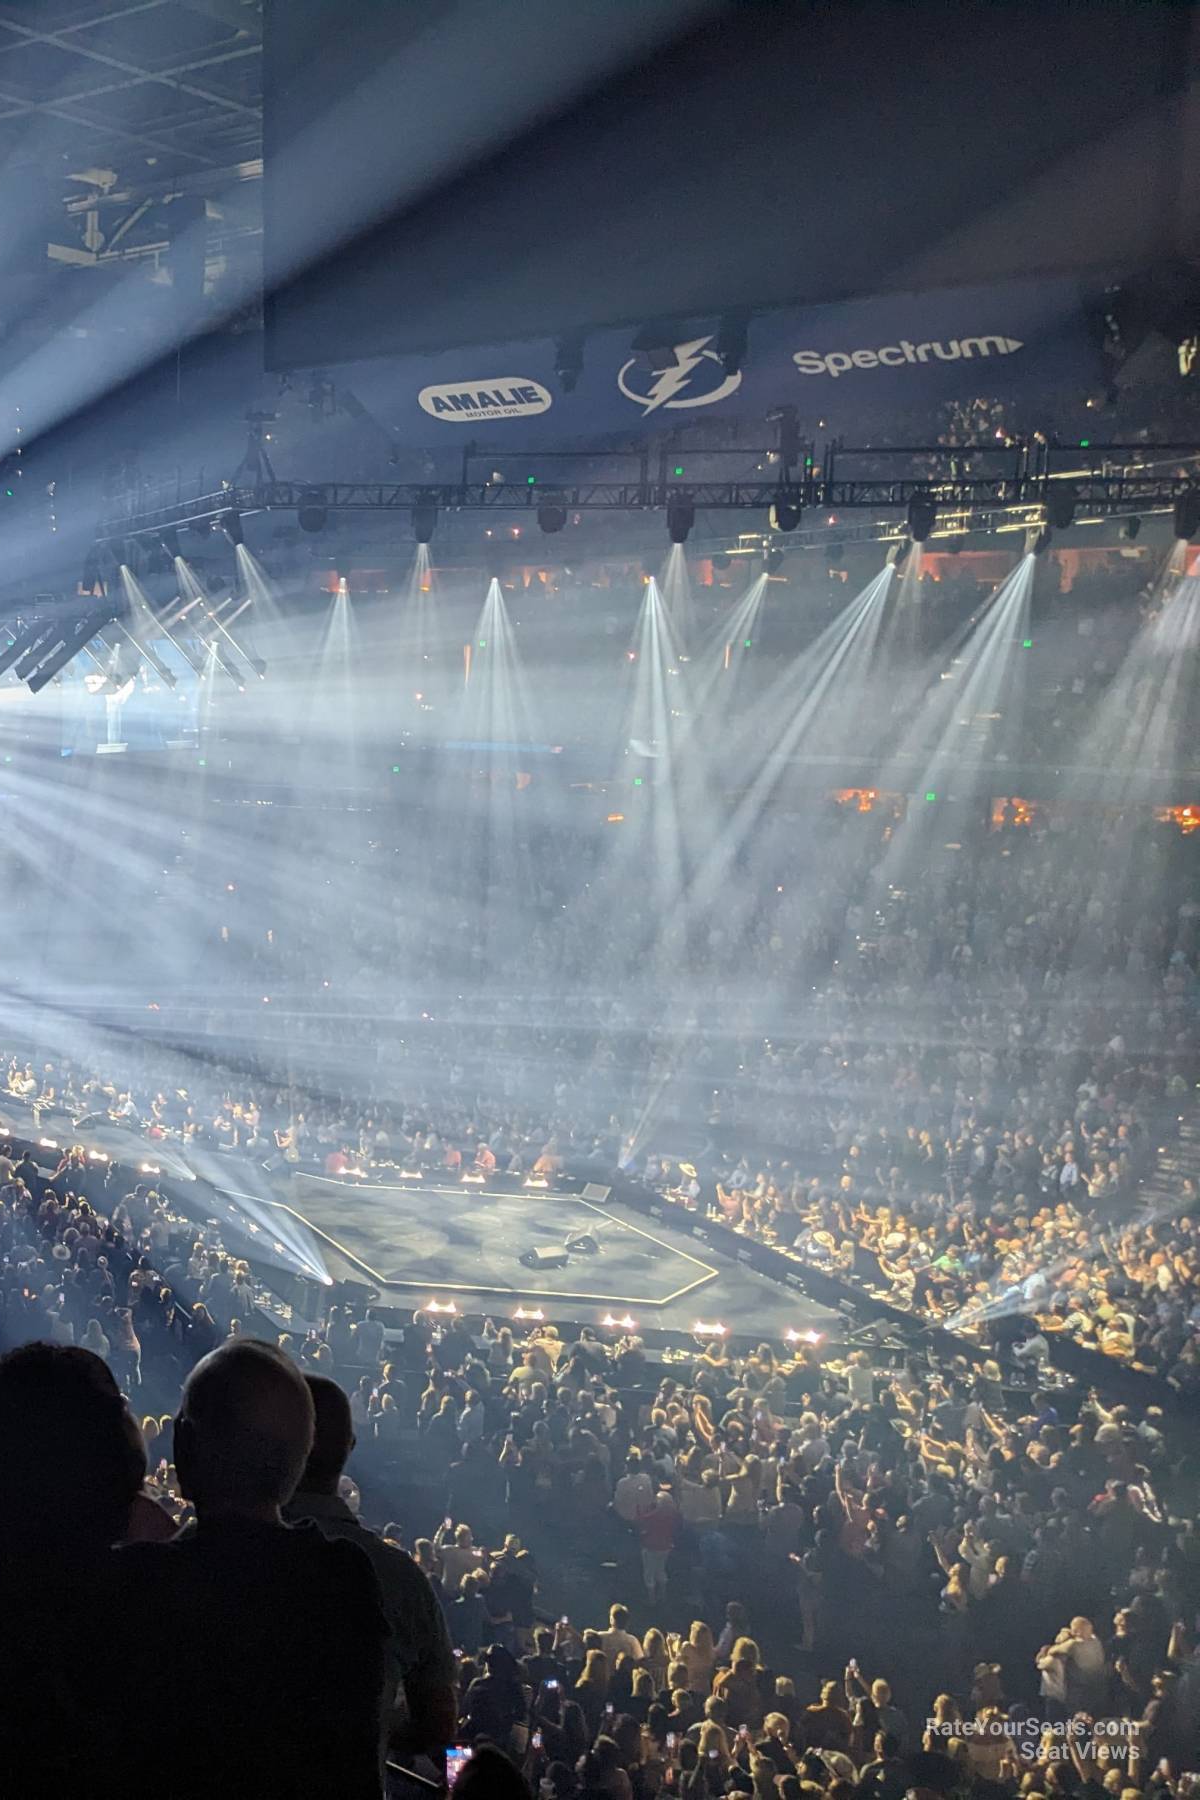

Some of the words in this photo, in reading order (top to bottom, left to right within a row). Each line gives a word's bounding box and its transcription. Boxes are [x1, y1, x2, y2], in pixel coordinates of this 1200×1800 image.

[793, 334, 1007, 377] Spectrum
[431, 385, 544, 413] AMALIE
[465, 409, 501, 418] MOTOR
[504, 407, 521, 415] OIL
